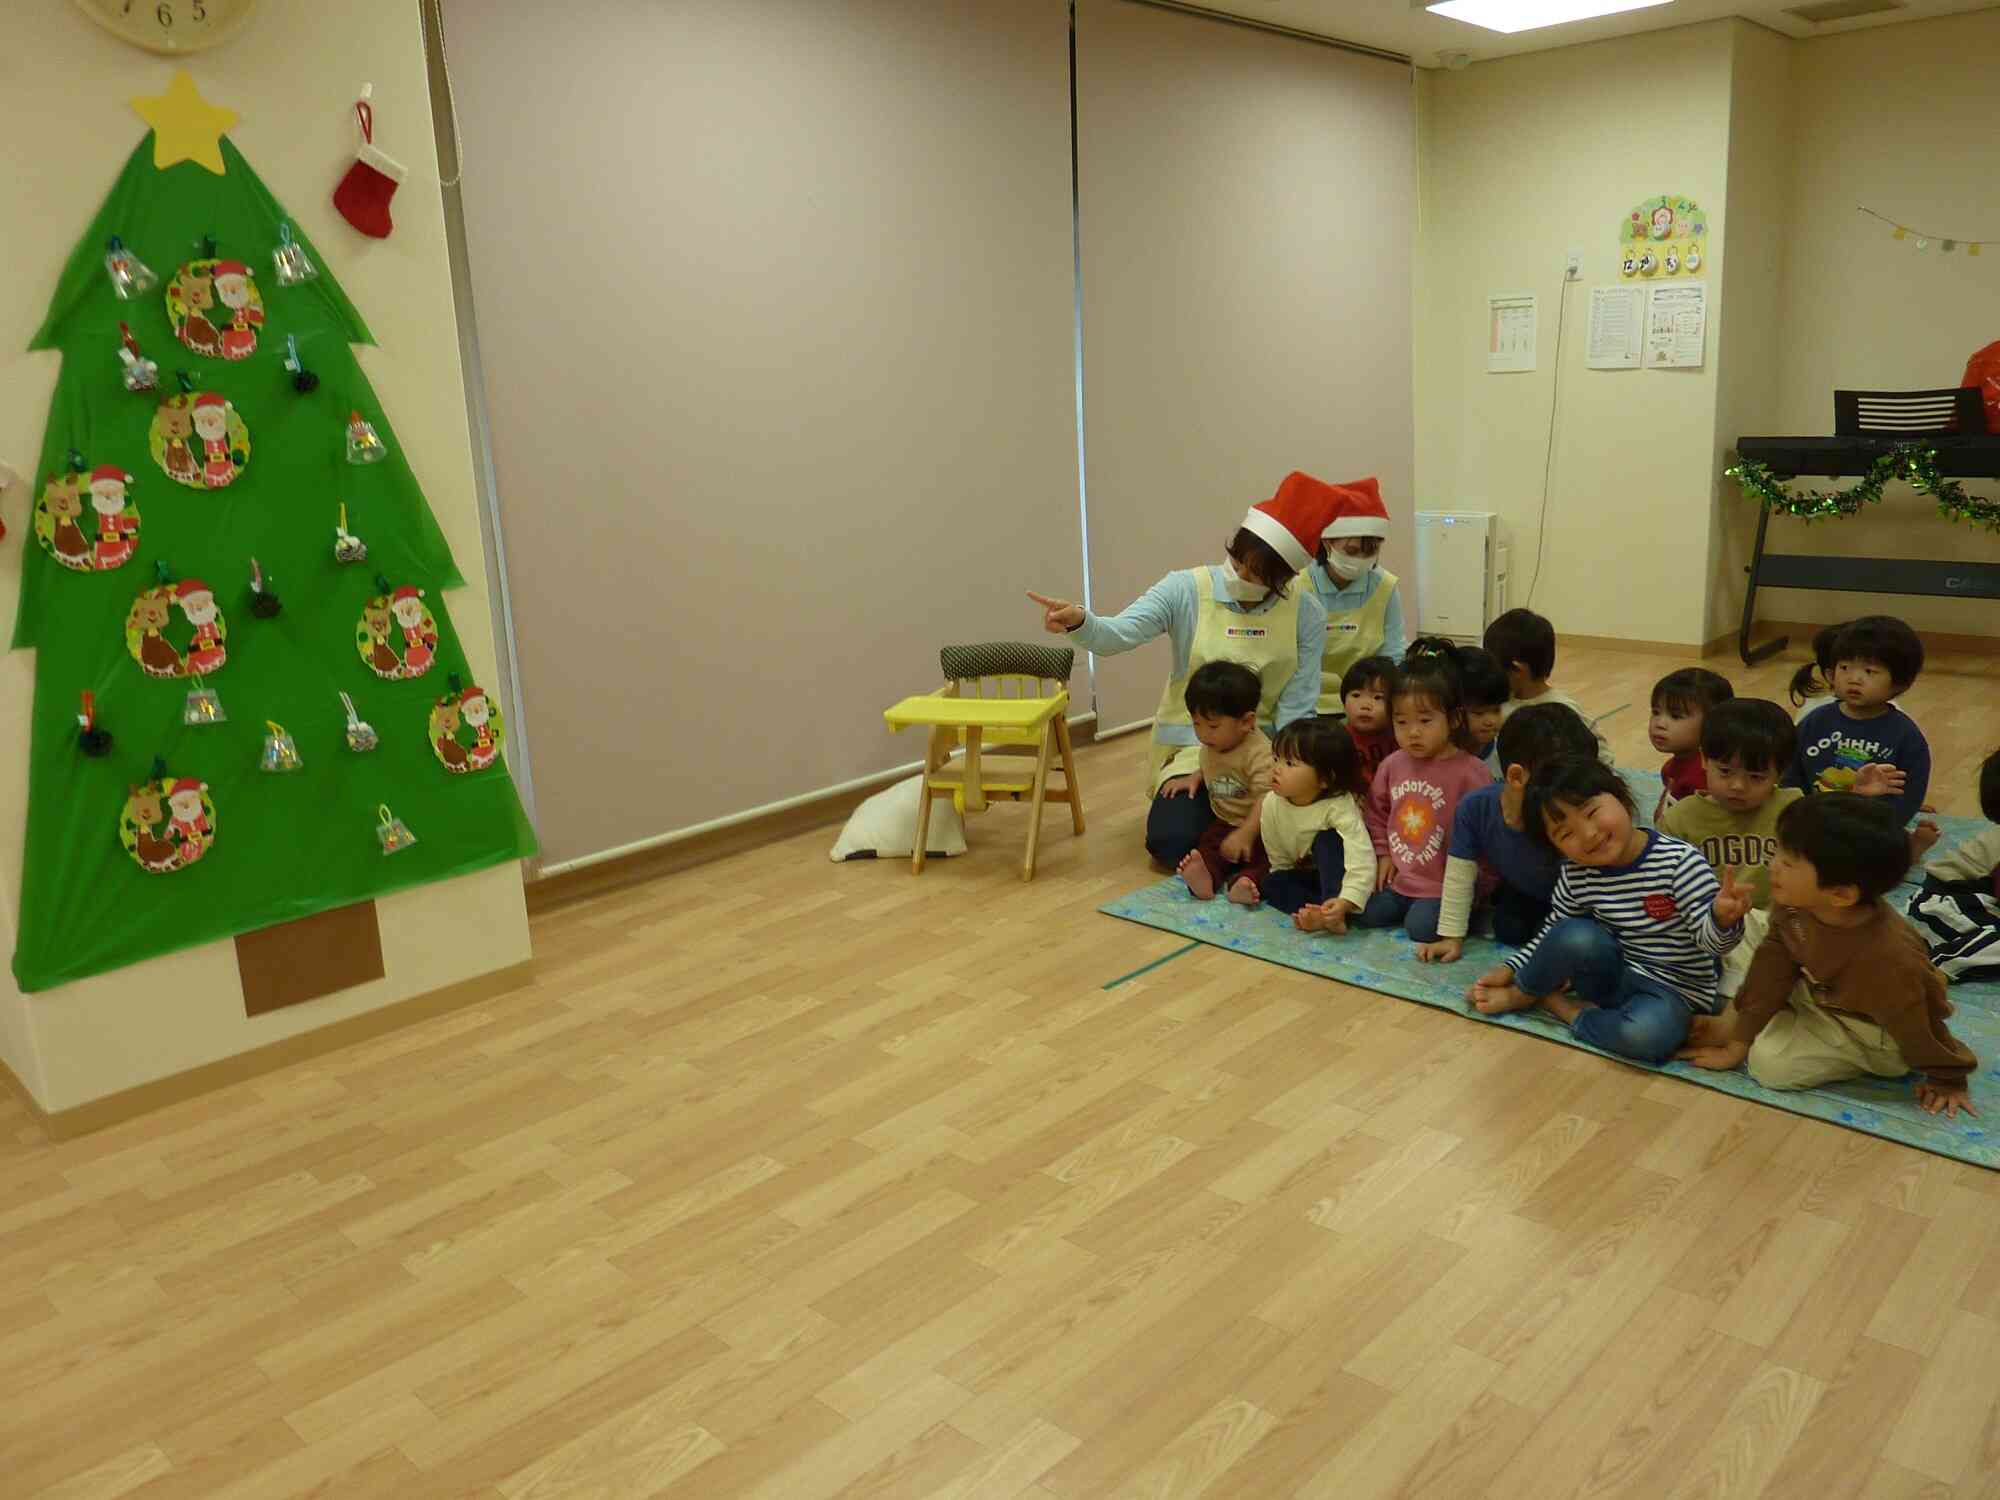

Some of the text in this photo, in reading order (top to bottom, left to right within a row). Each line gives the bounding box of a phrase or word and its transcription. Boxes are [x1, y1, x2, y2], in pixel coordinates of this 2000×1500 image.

[156, 3, 173, 28] 6
[192, 0, 206, 22] 5
[1391, 780, 1446, 810] ENJOY THE
[1389, 831, 1415, 865] LITTLE
